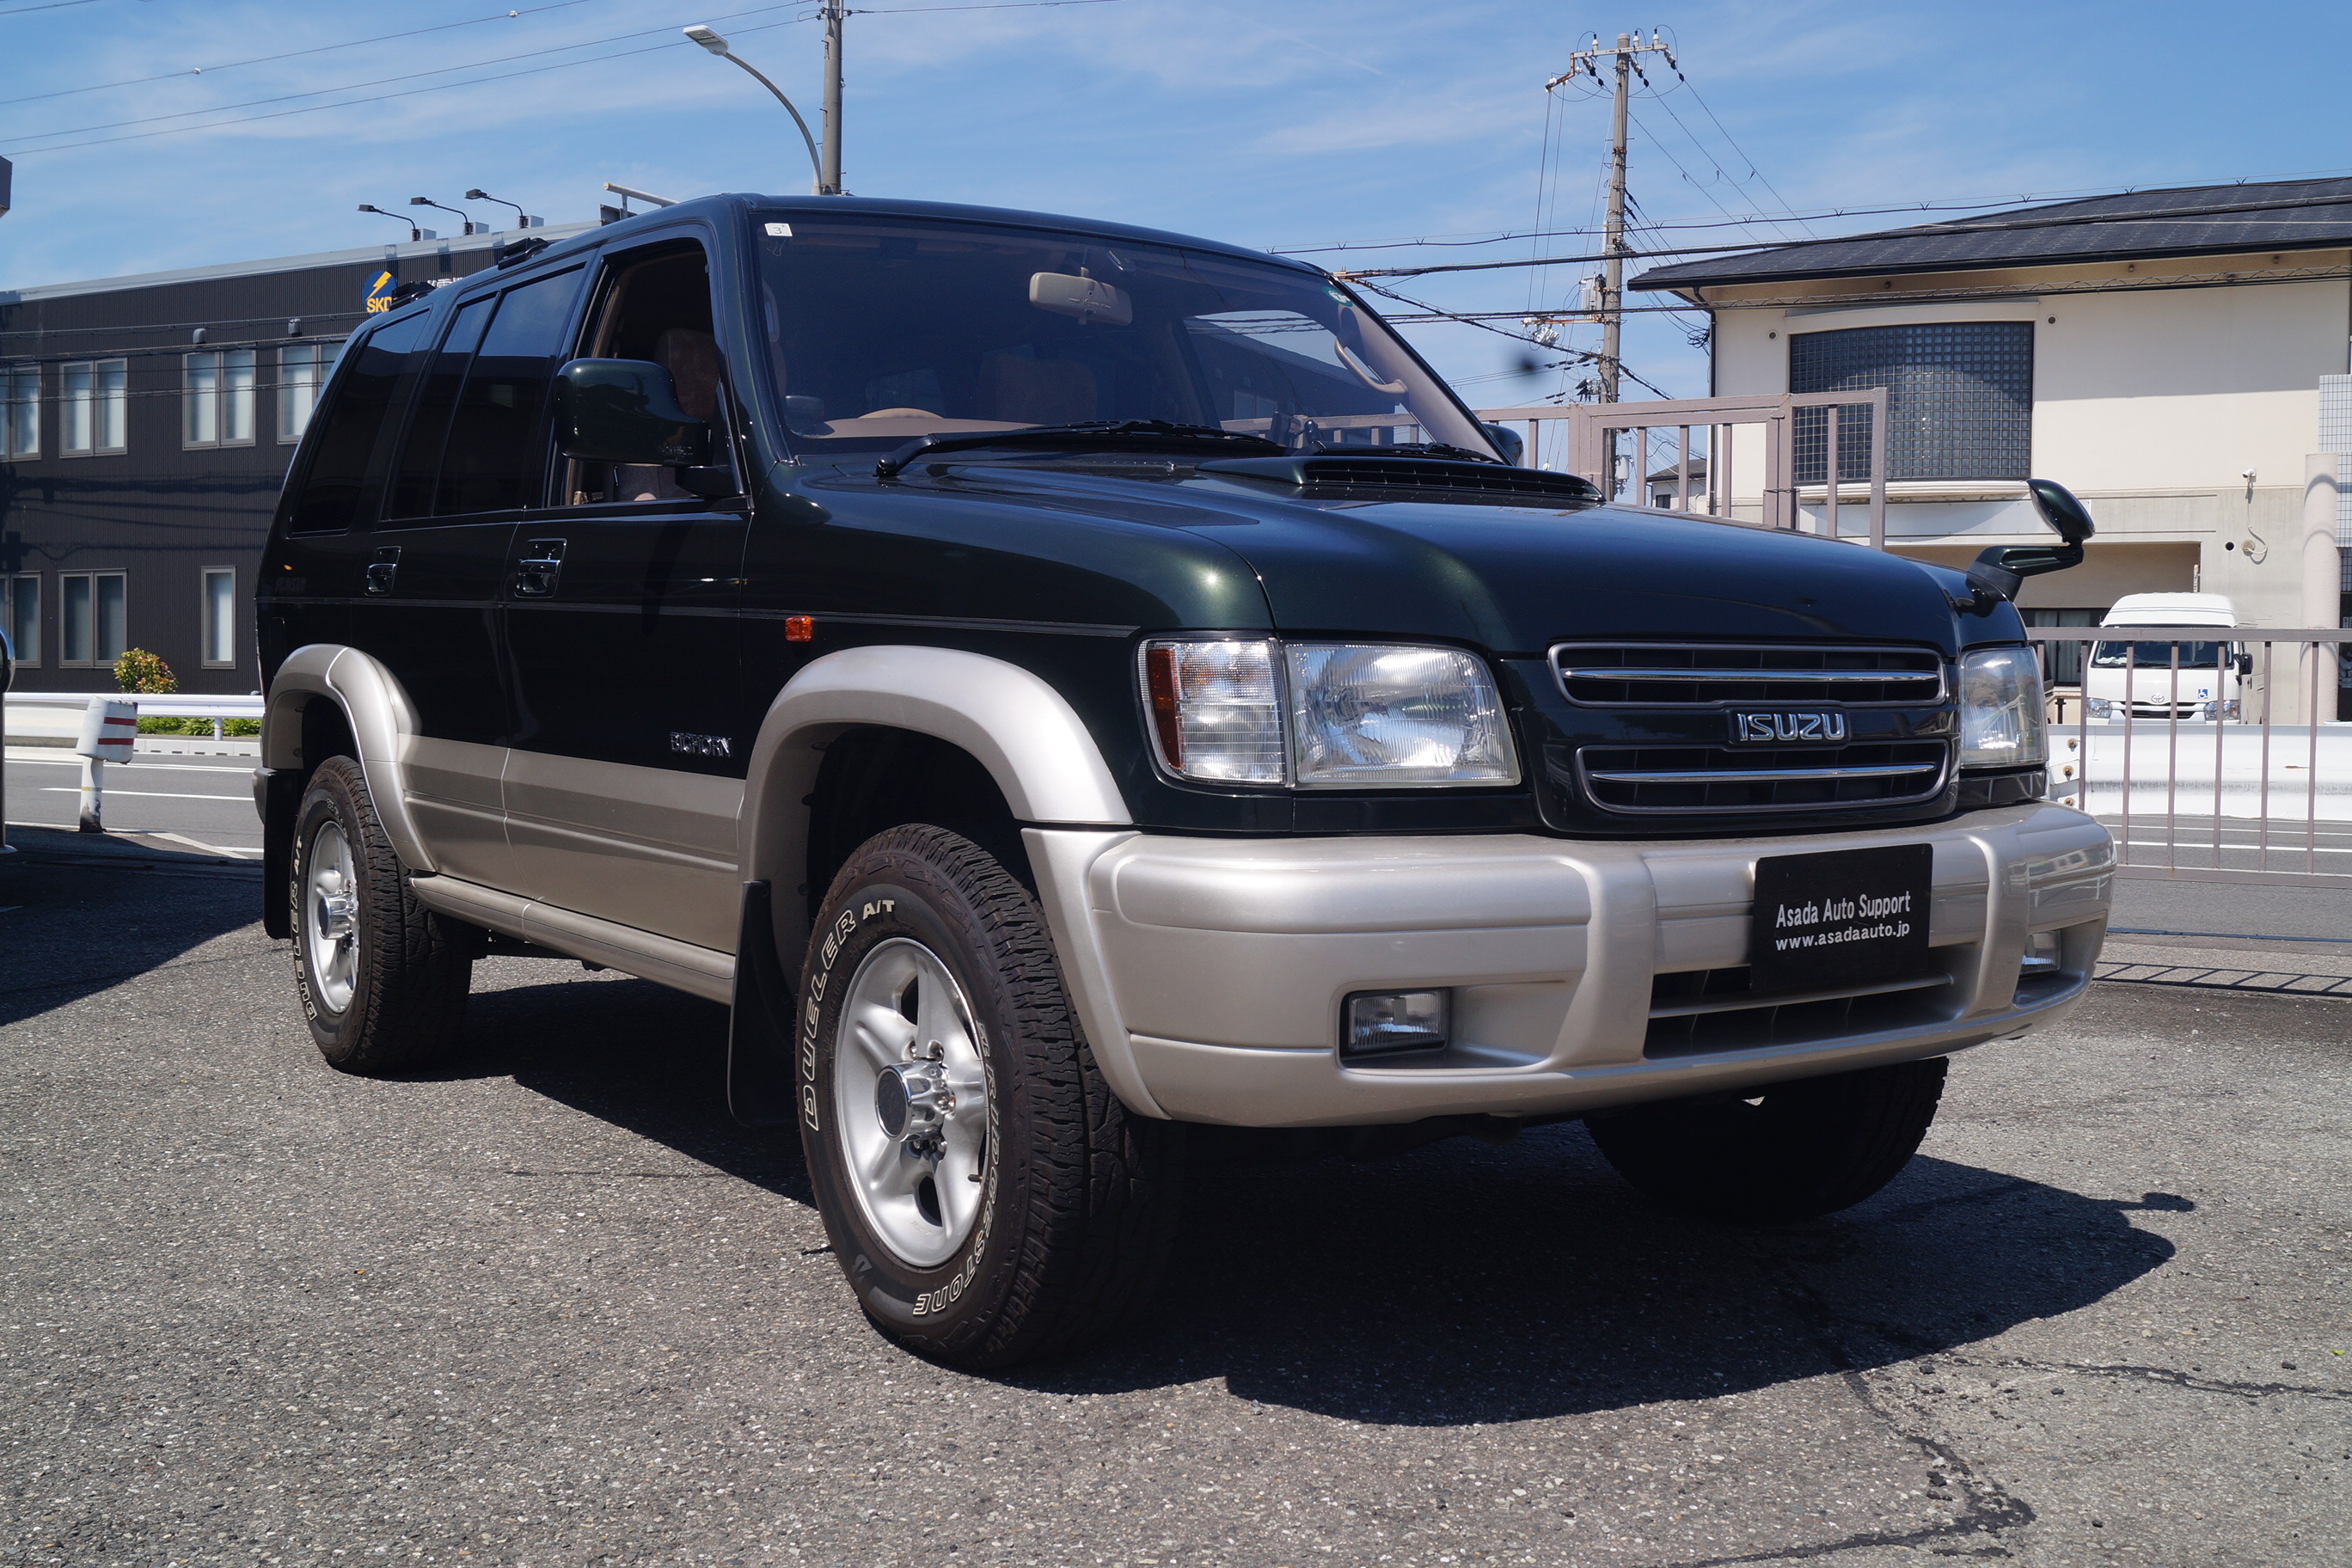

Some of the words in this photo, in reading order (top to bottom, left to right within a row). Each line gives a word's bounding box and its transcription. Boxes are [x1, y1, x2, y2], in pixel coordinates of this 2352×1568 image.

[670, 732, 732, 757] BIGHORN
[1736, 713, 1846, 742] ISUZU
[1775, 900, 1819, 928] Asada
[1822, 897, 1855, 922] Auto
[1859, 890, 1911, 920] Support
[1775, 920, 1910, 951] www.asadaauto.jp
[802, 909, 857, 1131] DUELER
[862, 899, 896, 921] A/T
[912, 1018, 1004, 1316] BRIDGESTONE
